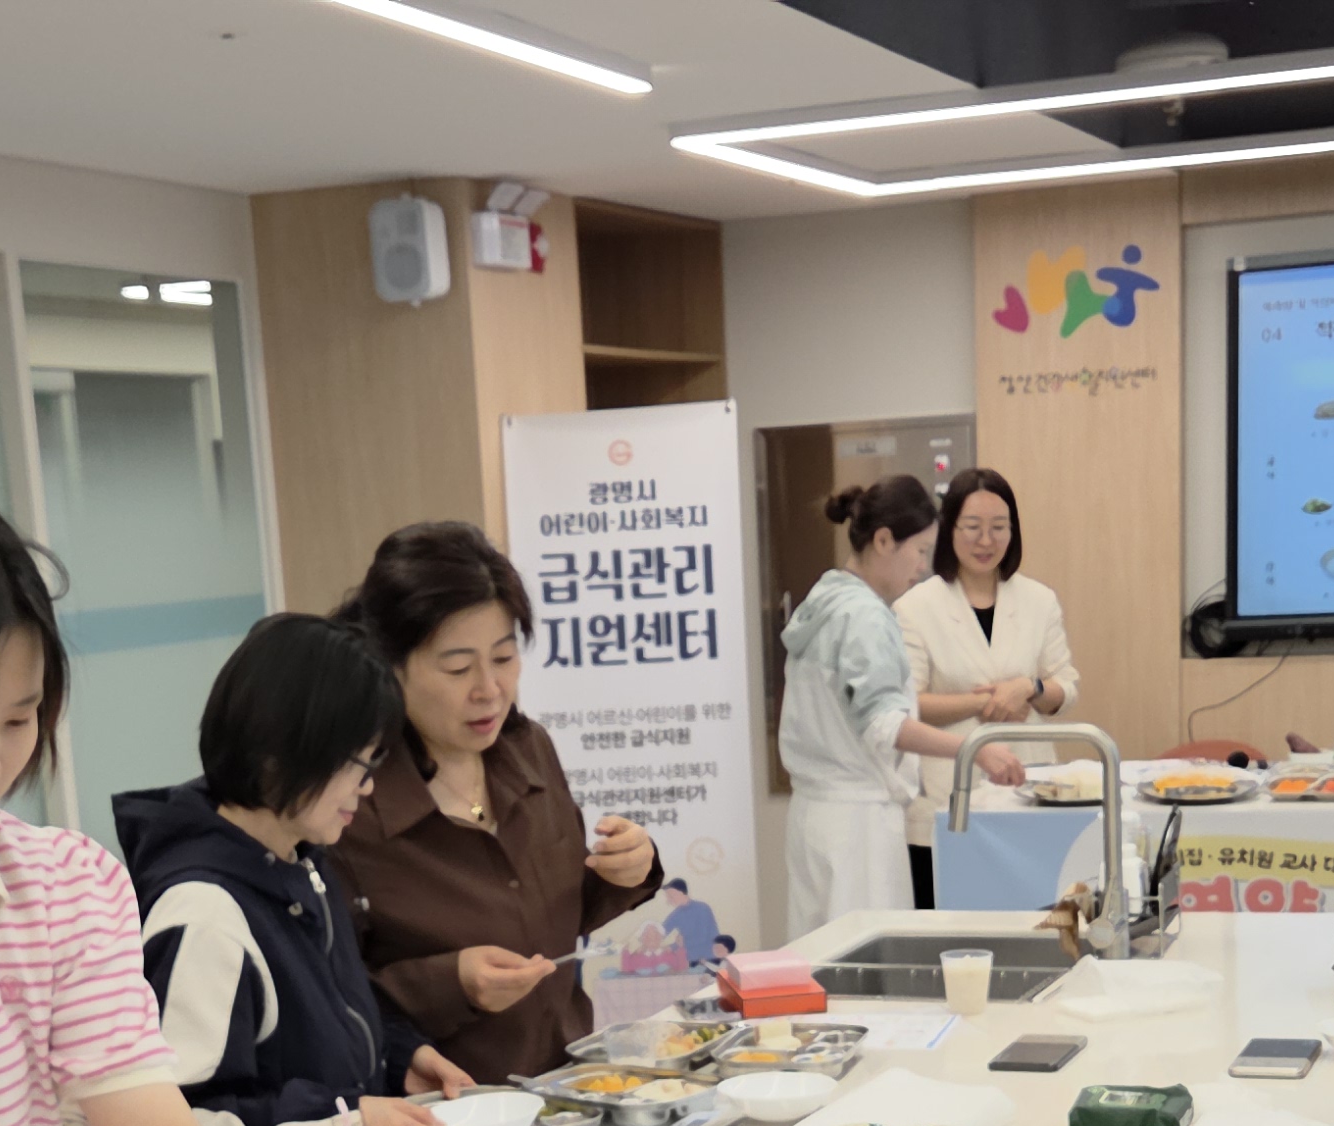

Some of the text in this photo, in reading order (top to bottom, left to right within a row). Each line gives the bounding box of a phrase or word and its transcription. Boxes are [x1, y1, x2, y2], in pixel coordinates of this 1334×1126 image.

[1261, 327, 1282, 343] 04
[589, 478, 657, 506] 광명시
[540, 504, 709, 537] 어린이·사회복지
[537, 543, 715, 605] 급식관리
[540, 608, 719, 668] 지원센터
[701, 701, 732, 721] 위한
[580, 726, 692, 751] 안전한 급식지원
[1278, 852, 1317, 872] 교사
